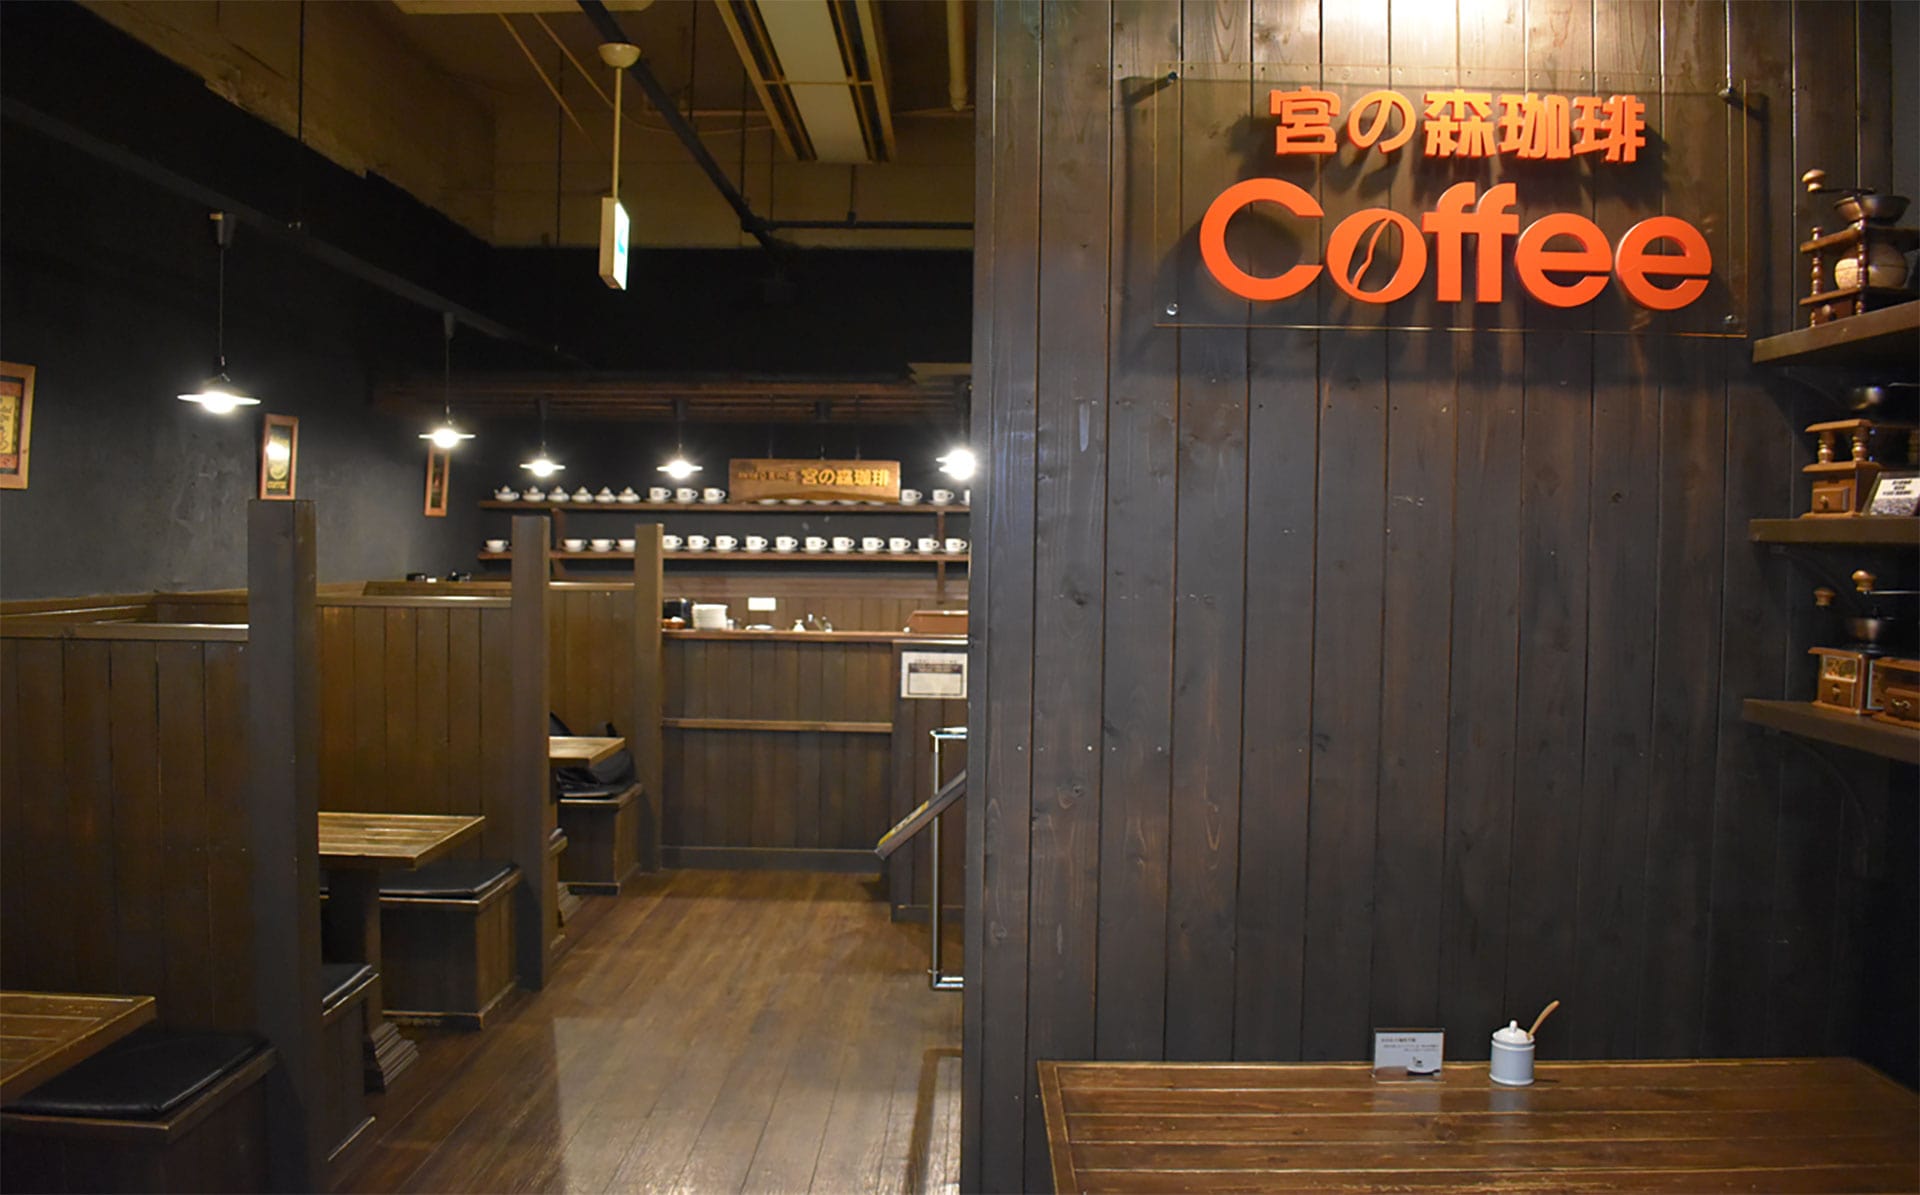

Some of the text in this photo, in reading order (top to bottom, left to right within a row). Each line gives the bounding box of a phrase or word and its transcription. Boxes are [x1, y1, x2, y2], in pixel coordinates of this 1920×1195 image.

[1269, 87, 1647, 163] 宮の森珈琲
[1199, 177, 1712, 310] Coffee
